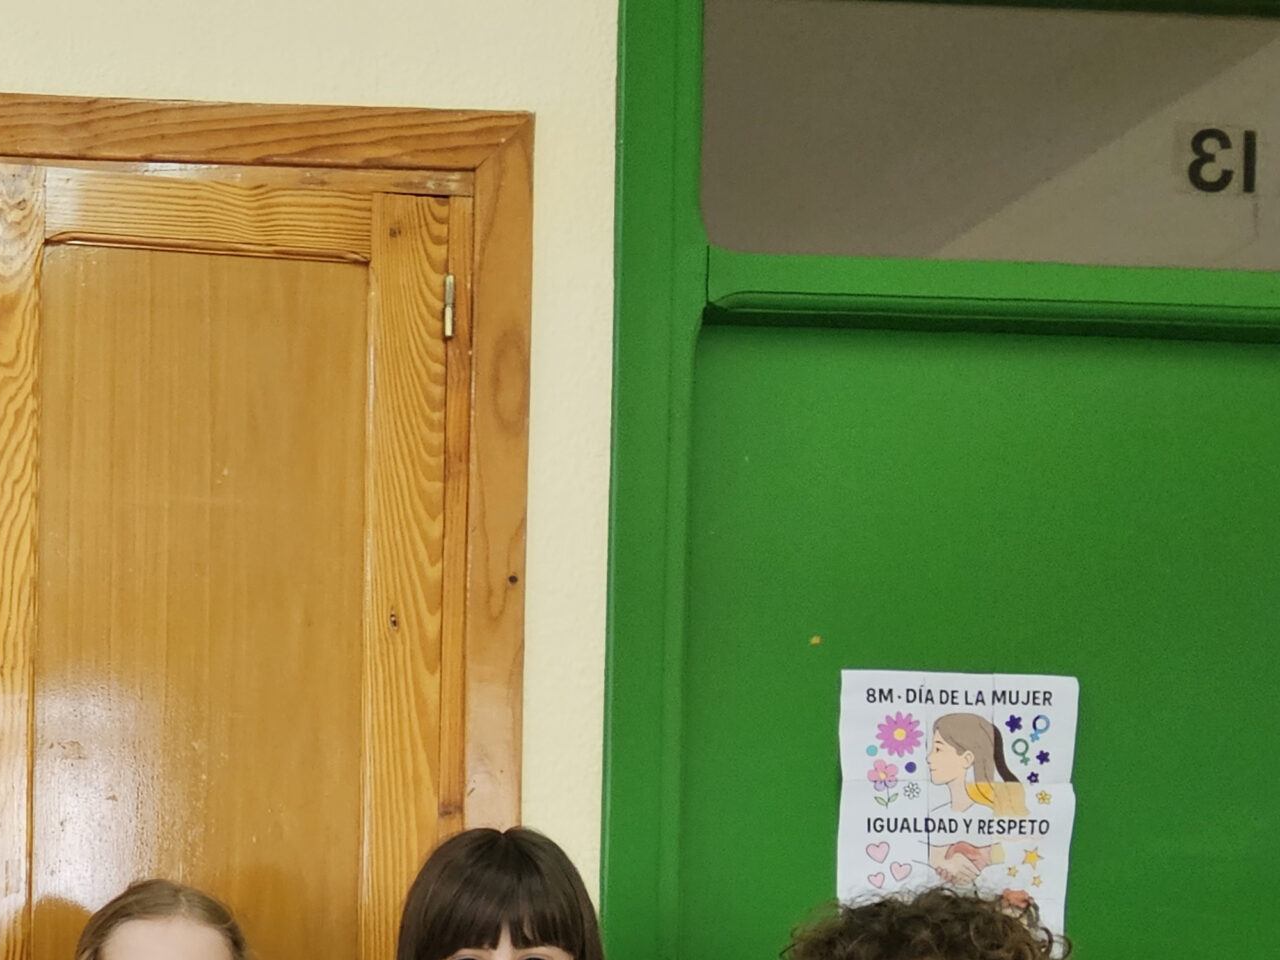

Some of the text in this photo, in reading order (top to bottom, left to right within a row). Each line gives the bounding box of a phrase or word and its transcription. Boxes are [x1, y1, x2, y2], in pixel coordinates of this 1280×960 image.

[866, 684, 1053, 707] 8M DÍA DE LA MUJER
[867, 817, 1050, 836] IGUALDAD Y RESPETO
